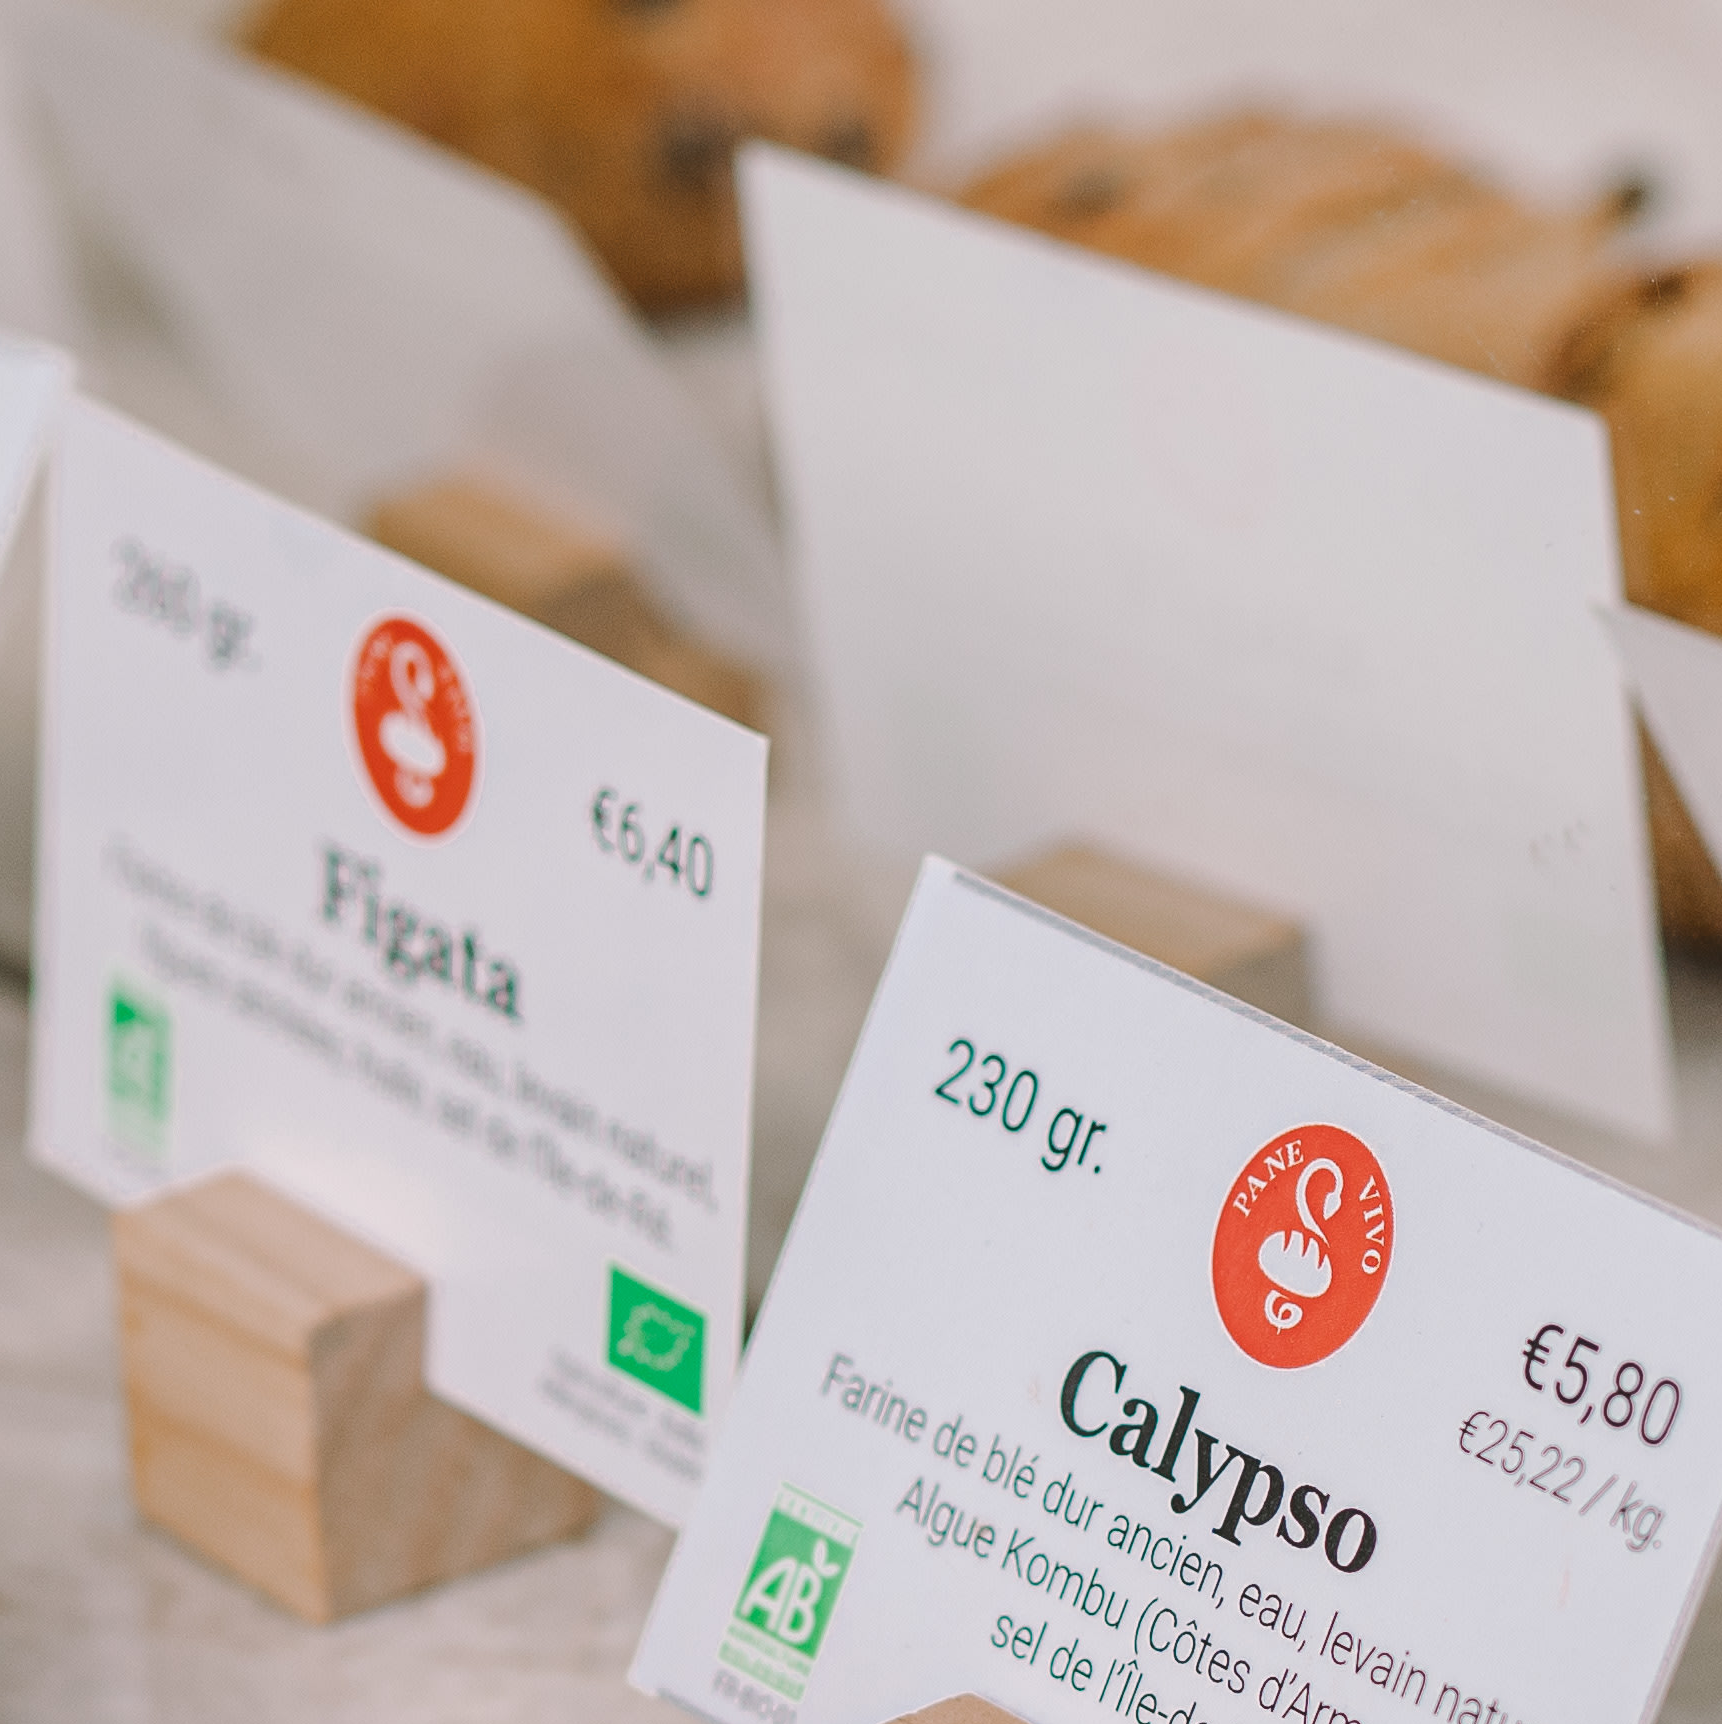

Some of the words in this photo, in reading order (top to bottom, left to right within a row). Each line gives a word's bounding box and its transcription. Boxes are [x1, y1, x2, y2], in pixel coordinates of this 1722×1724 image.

[590, 786, 715, 899] €6,40
[318, 839, 522, 1026] Figata
[934, 1037, 1039, 1133] 230
[1041, 1108, 1107, 1174] gr.
[1232, 1138, 1306, 1219] PANE
[1359, 1174, 1386, 1275] VIVO
[1523, 1324, 1682, 1445] €5,80
[819, 1353, 927, 1442] Farine
[933, 1414, 977, 1469] de
[983, 1434, 1039, 1499] blé
[1043, 1472, 1103, 1532] dur
[1107, 1513, 1224, 1610] ancien,
[1239, 1583, 1307, 1653] eau,
[1319, 1611, 1427, 1705] levain
[1060, 1351, 1378, 1573] Calypso
[1458, 1411, 1585, 1503] €25,22
[1580, 1475, 1619, 1515] /
[1611, 1481, 1666, 1552] kg.
[740, 1556, 823, 1644] AB
[895, 1476, 995, 1558] Algue
[1002, 1529, 1129, 1629] Kombu
[1134, 1597, 1250, 1694] (Côtes
[991, 1615, 1047, 1665] sel
[1049, 1638, 1093, 1690] de
